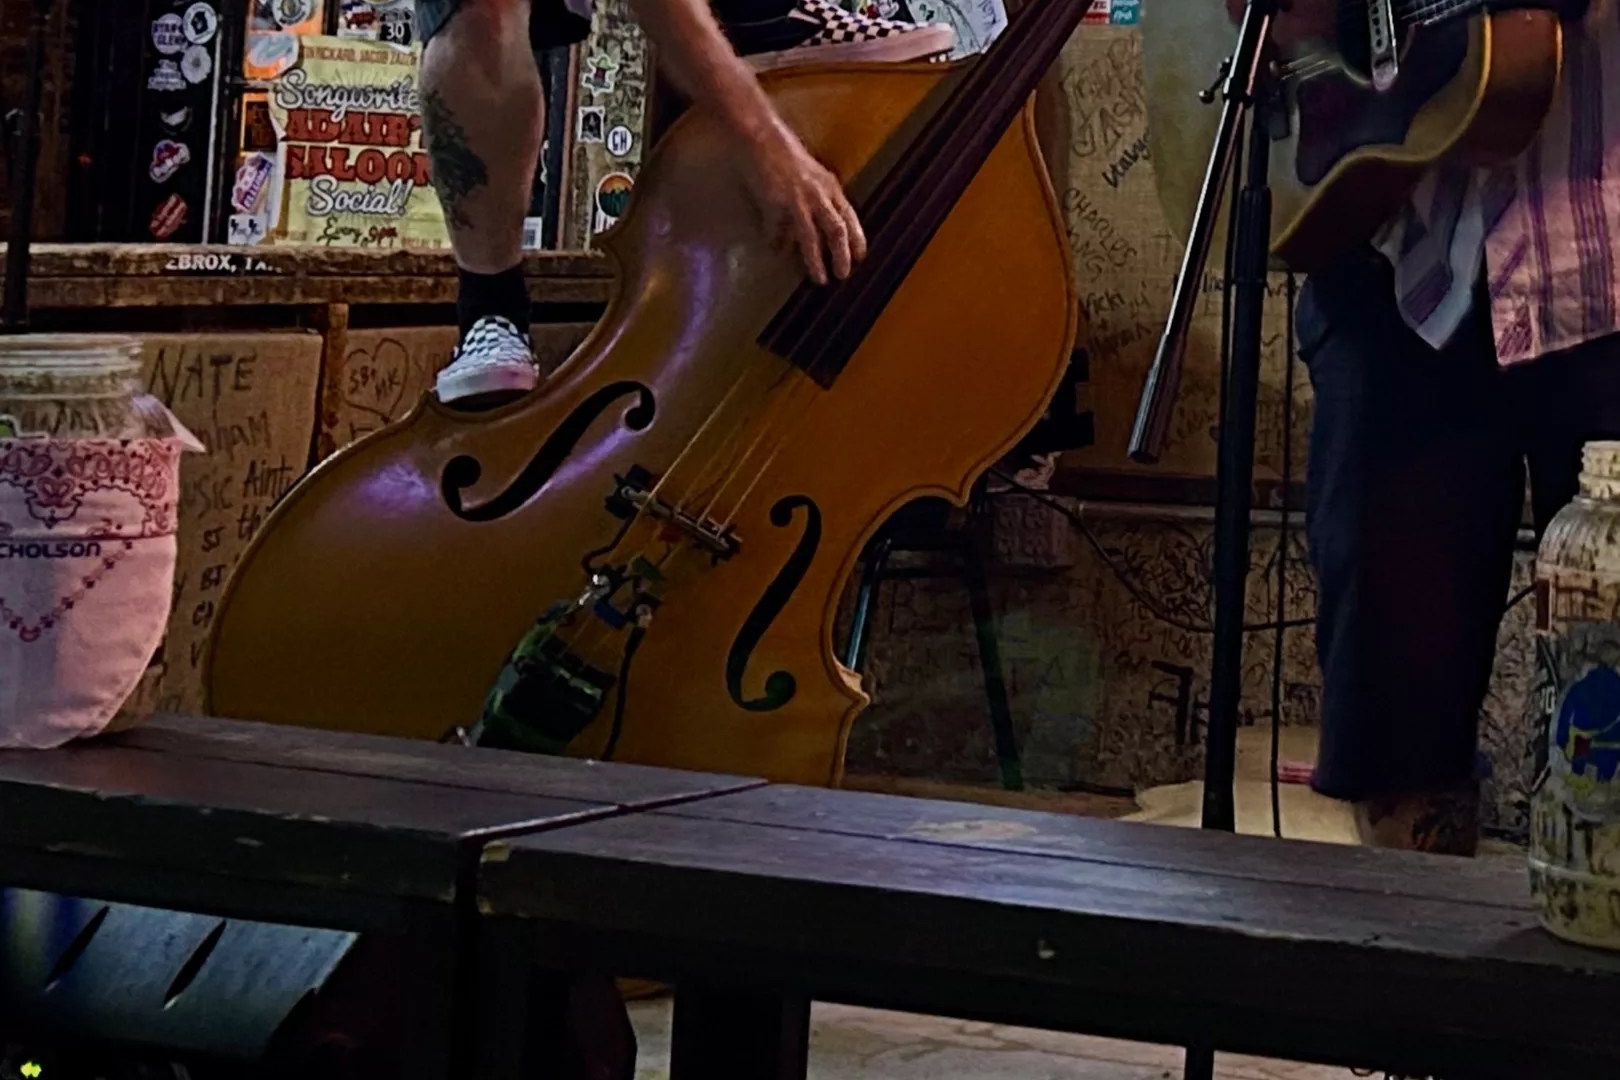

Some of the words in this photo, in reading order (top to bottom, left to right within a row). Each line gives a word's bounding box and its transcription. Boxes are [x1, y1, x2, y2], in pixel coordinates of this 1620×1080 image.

[386, 24, 405, 40] 30
[307, 173, 413, 215] Social!
[148, 344, 257, 410] NATE
